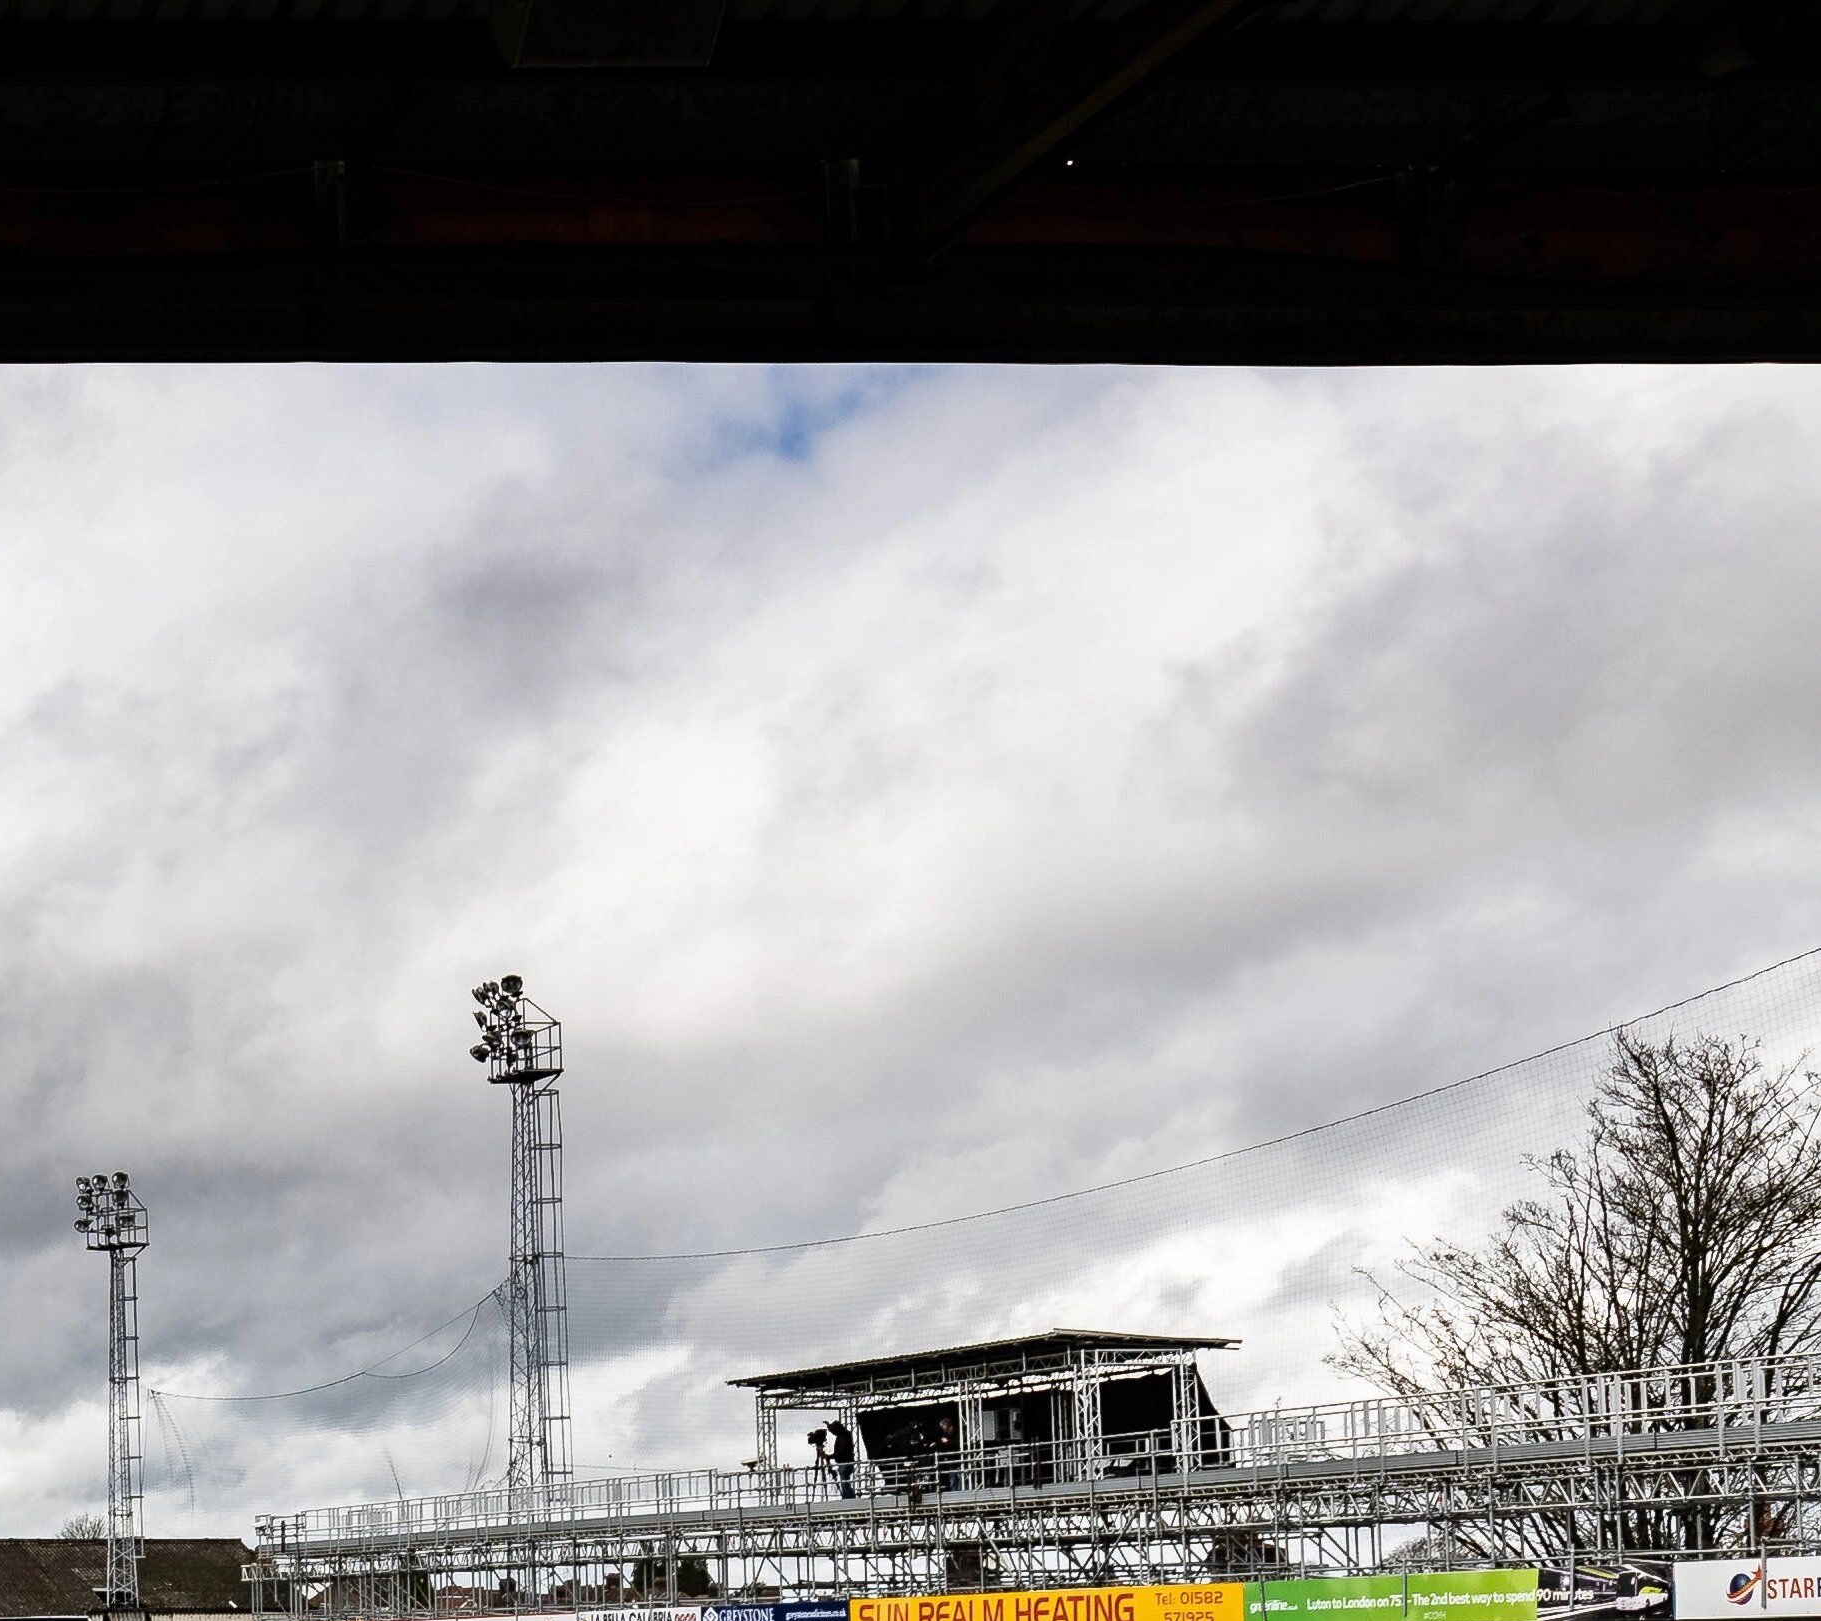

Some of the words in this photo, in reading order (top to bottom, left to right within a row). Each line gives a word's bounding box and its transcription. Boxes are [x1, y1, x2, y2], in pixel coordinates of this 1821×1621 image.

[1155, 1591, 1175, 1606] Tel:
[1180, 1590, 1223, 1605] 01582
[1307, 1596, 1330, 1609] Luton
[1331, 1597, 1341, 1608] to
[1343, 1595, 1374, 1608] London
[1375, 1597, 1387, 1607] on
[1413, 1594, 1428, 1605] The
[1430, 1593, 1446, 1605] 2nd
[1449, 1593, 1469, 1604] best
[1471, 1594, 1491, 1607] way
[1493, 1592, 1503, 1603] to
[1506, 1590, 1536, 1604] spend
[1537, 1589, 1550, 1600] 90
